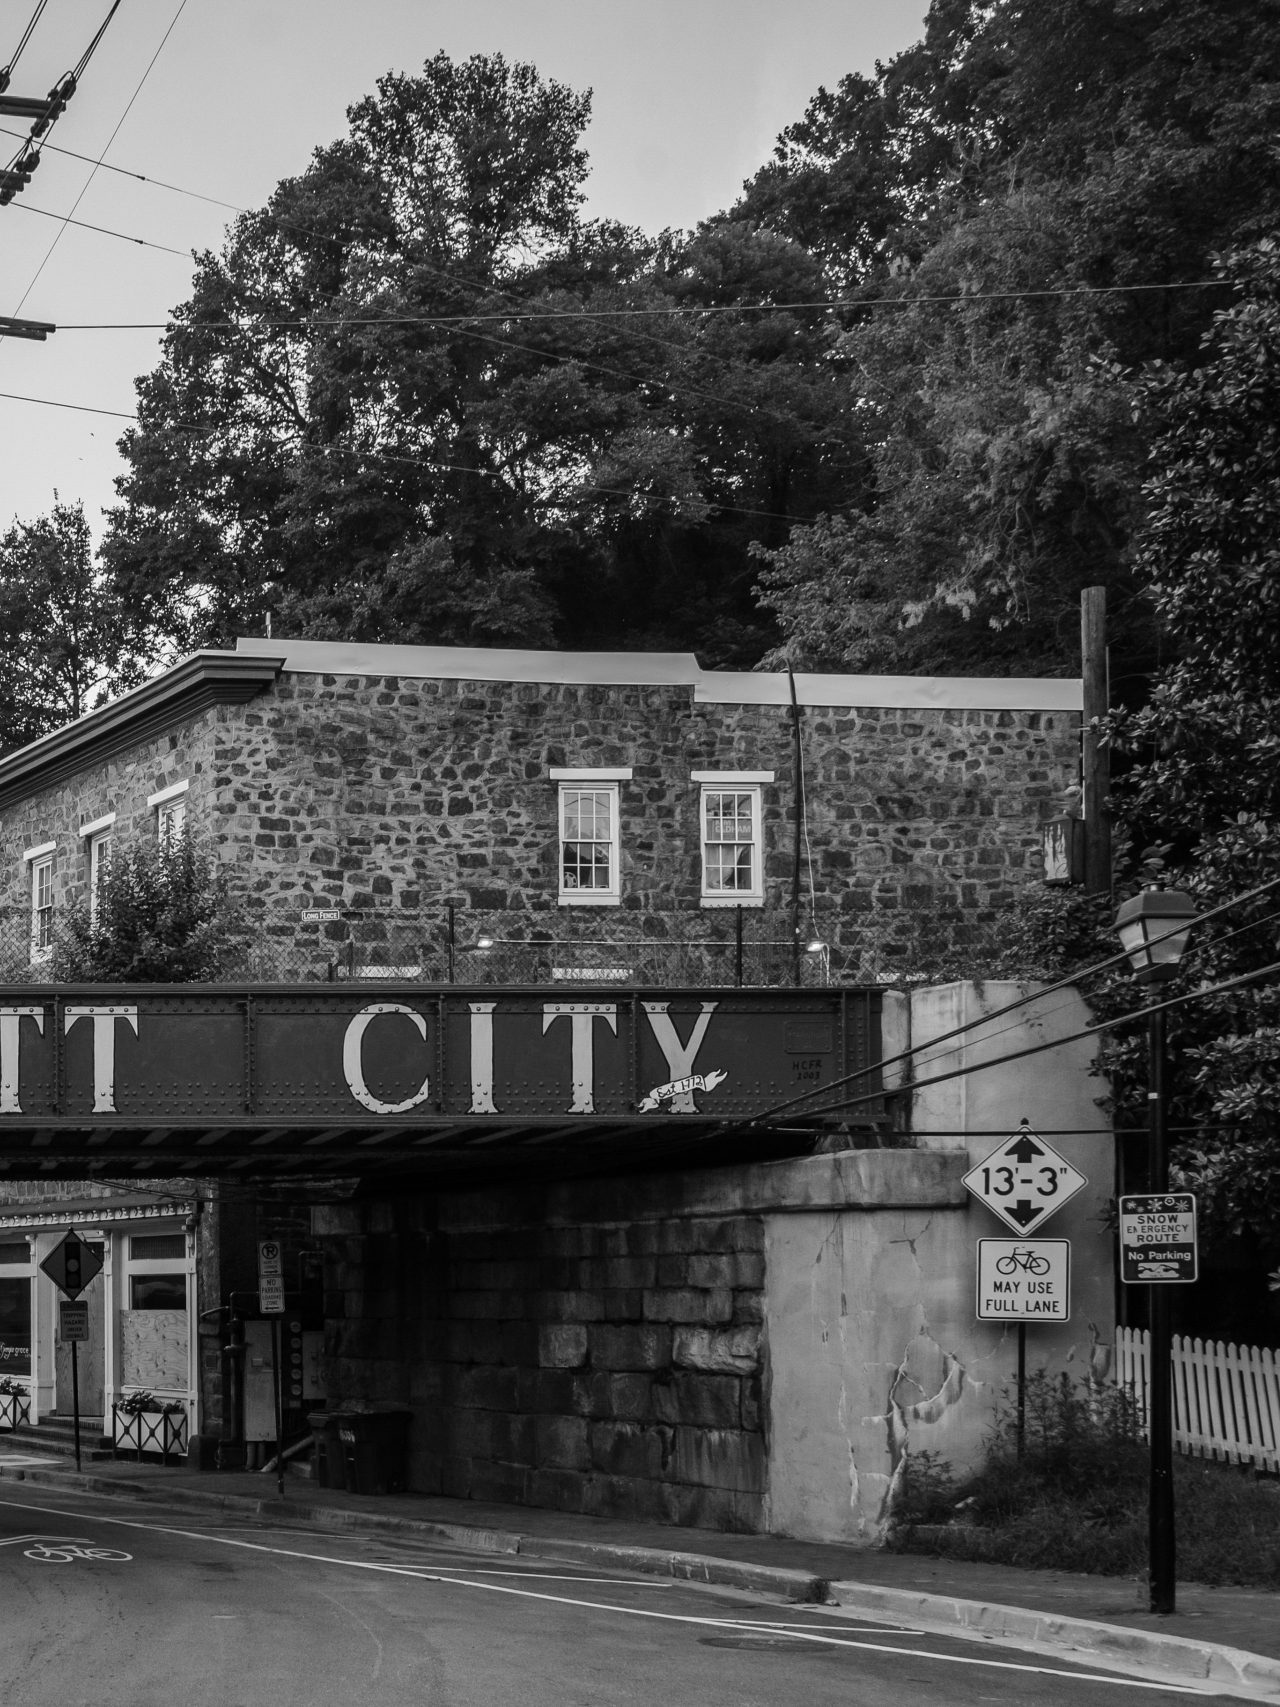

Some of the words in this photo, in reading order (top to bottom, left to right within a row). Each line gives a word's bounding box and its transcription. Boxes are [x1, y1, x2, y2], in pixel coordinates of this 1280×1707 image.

[303, 912, 319, 920] LONG
[319, 911, 338, 919] FENCE
[341, 1001, 720, 1115] CITY
[656, 1082, 677, 1098] Est
[681, 1075, 703, 1091] 1772
[1137, 1214, 1179, 1225] SNOW
[1136, 1233, 1180, 1243] ROUTE
[1128, 1251, 1145, 1261] No
[1148, 1251, 1192, 1261] Parking
[993, 1281, 1021, 1294] MAY
[1027, 1281, 1054, 1294] USE
[985, 1300, 1019, 1313] FULL
[1025, 1300, 1060, 1313] LANE
